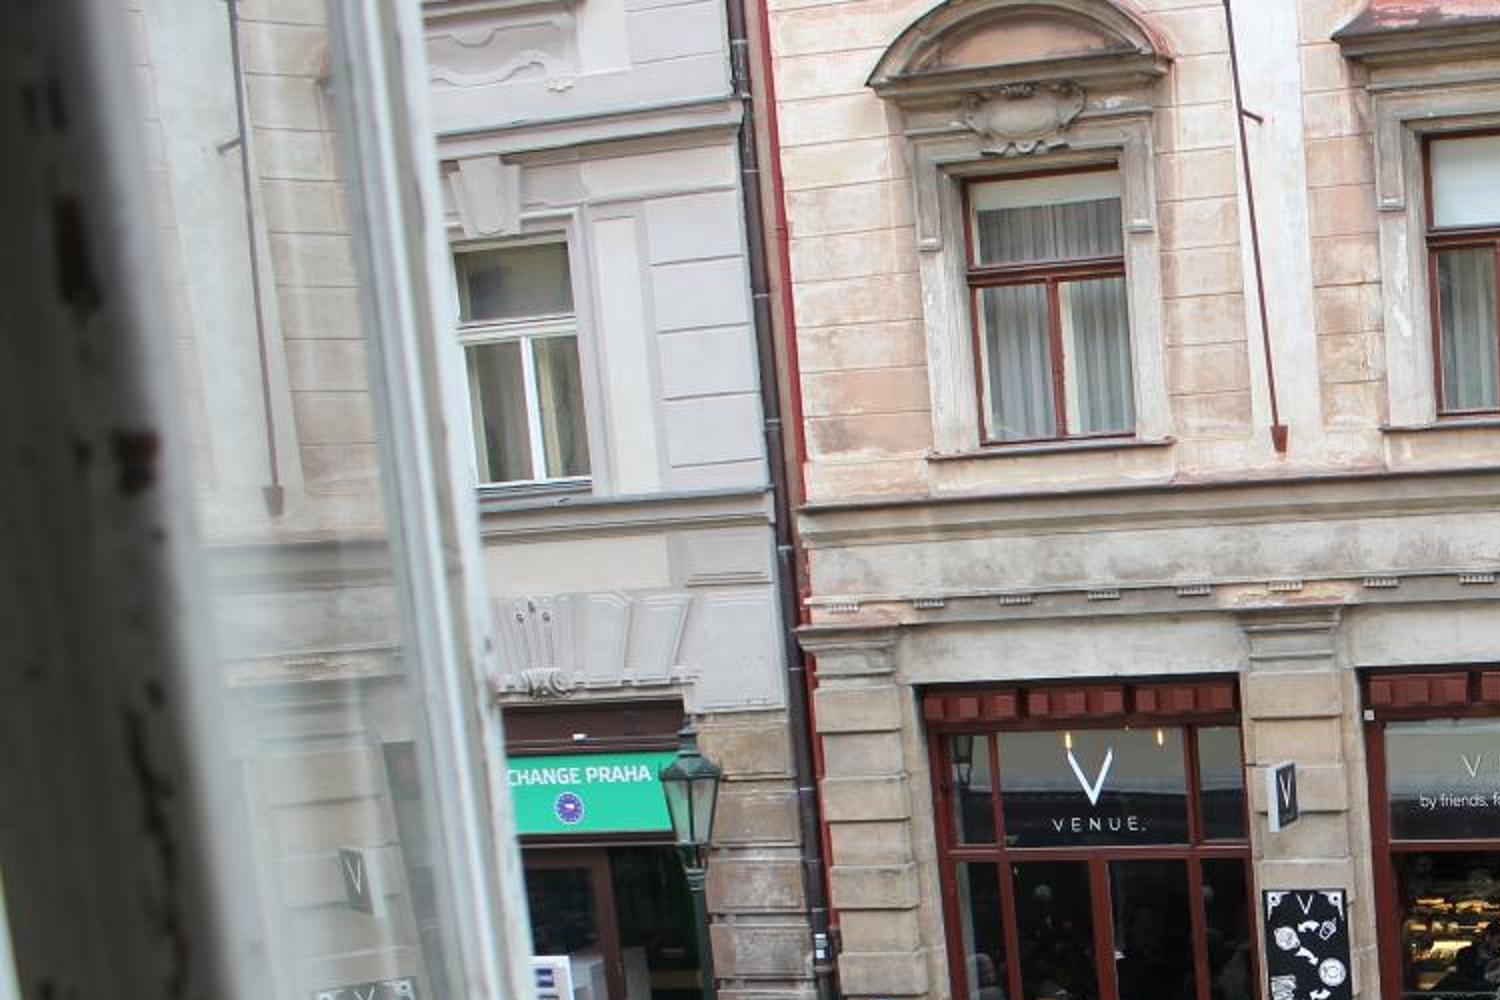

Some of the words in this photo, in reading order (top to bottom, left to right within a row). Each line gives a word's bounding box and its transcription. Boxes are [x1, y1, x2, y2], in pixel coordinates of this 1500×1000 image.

[585, 764, 652, 784] PRAHA
[1067, 748, 1113, 805] V
[1420, 793, 1437, 811] by
[1296, 893, 1313, 914] V
